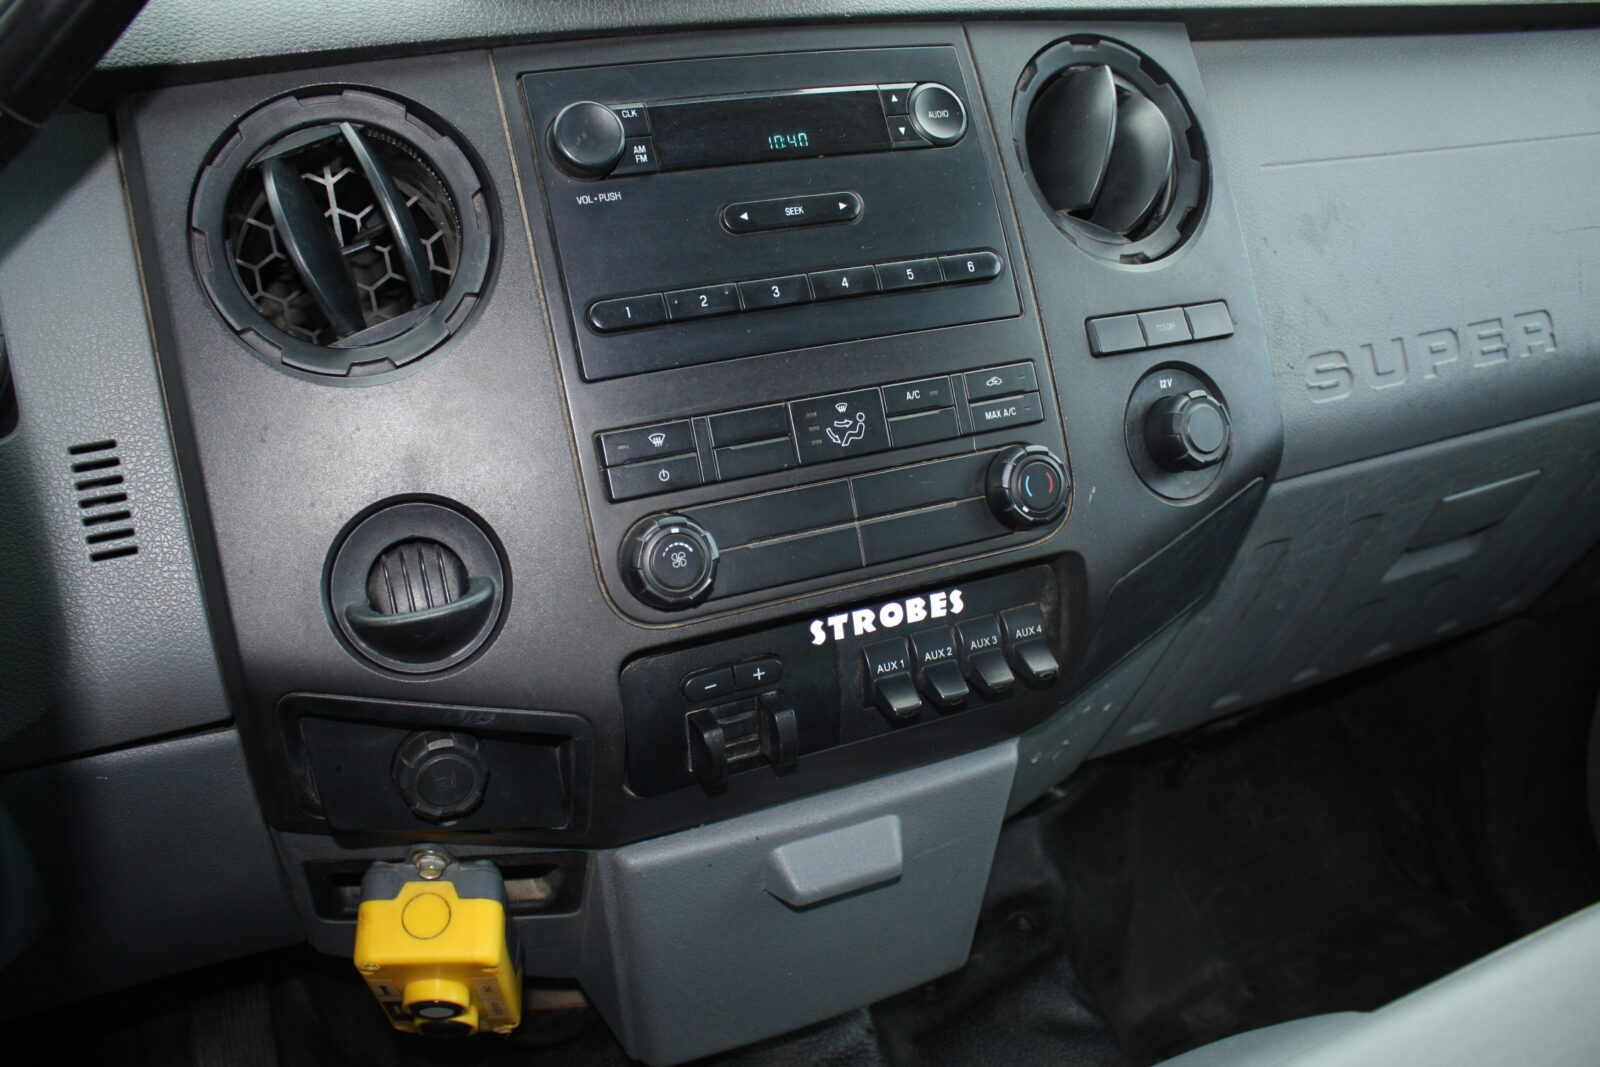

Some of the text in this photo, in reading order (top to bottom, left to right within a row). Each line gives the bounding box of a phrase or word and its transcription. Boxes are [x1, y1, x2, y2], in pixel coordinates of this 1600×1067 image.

[622, 109, 637, 118] CLK
[928, 110, 949, 119] AUDIO
[768, 132, 809, 149] 10:40
[633, 145, 647, 154] AM
[635, 154, 648, 163] FM
[784, 206, 804, 216] SEEK
[625, 261, 975, 318] 1 2 3 4 5 6
[1305, 308, 1557, 404] SUPER
[1159, 378, 1173, 389] 12V
[906, 390, 921, 400] A/C
[985, 407, 1017, 421] MAX A/C
[809, 589, 964, 646] STROBES
[1015, 624, 1042, 639] AUX 4
[970, 636, 998, 650] AUX 3
[924, 647, 953, 662] AUX 2
[877, 660, 905, 674] AUX 1
